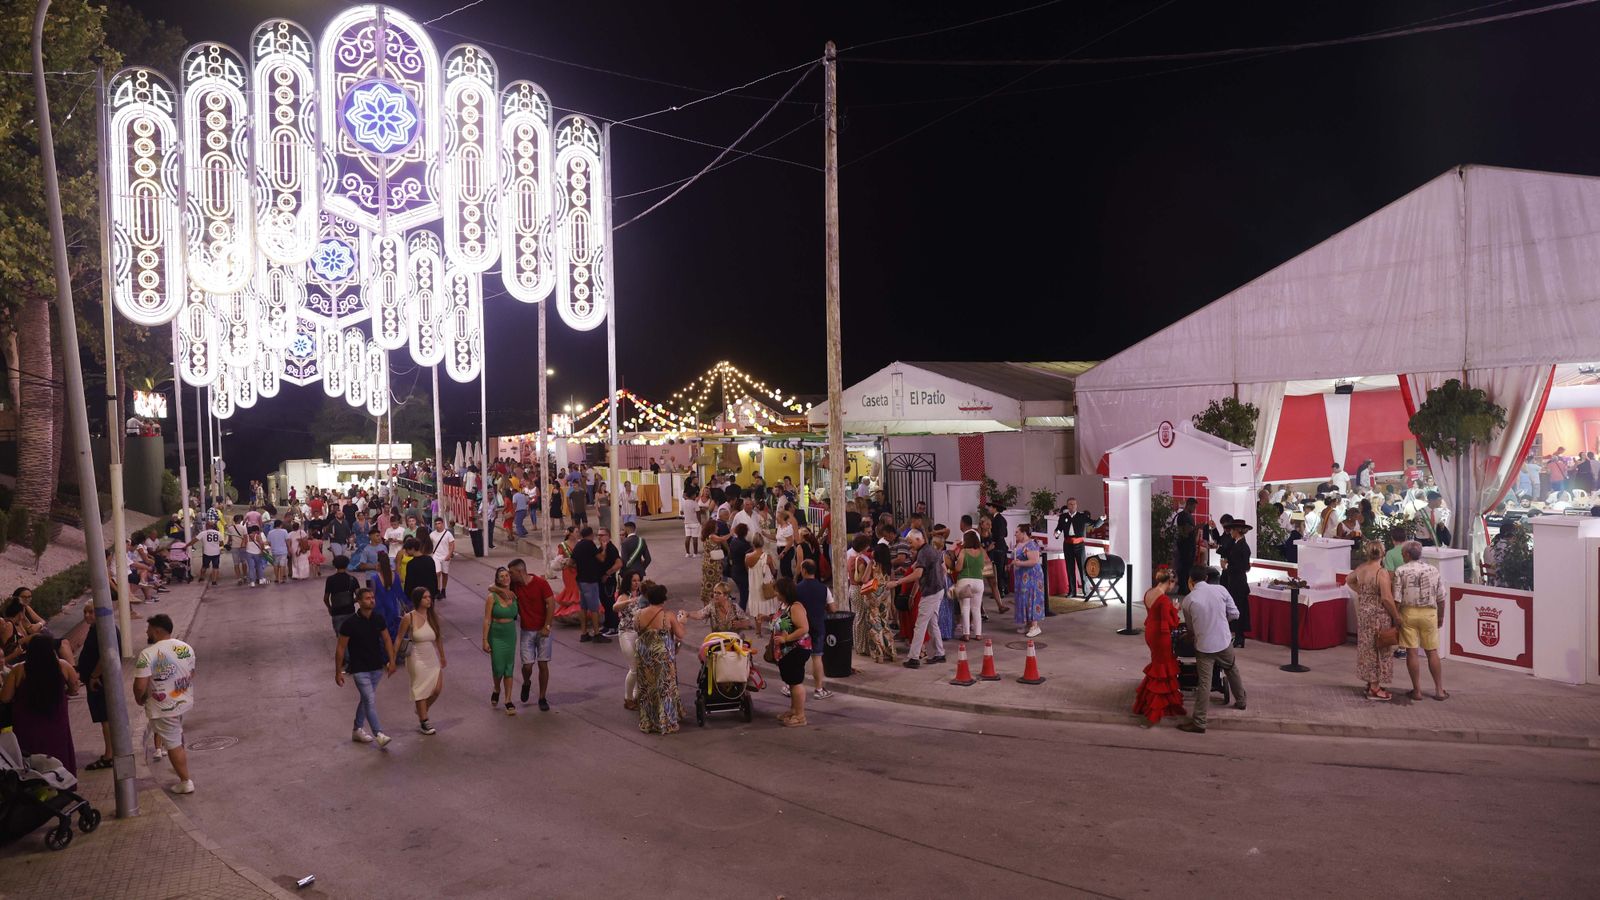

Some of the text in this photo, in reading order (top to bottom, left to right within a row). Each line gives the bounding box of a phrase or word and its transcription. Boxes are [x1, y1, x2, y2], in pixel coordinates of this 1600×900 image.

[861, 390, 945, 407] Caseta El Patio
[206, 533, 219, 543] 68
